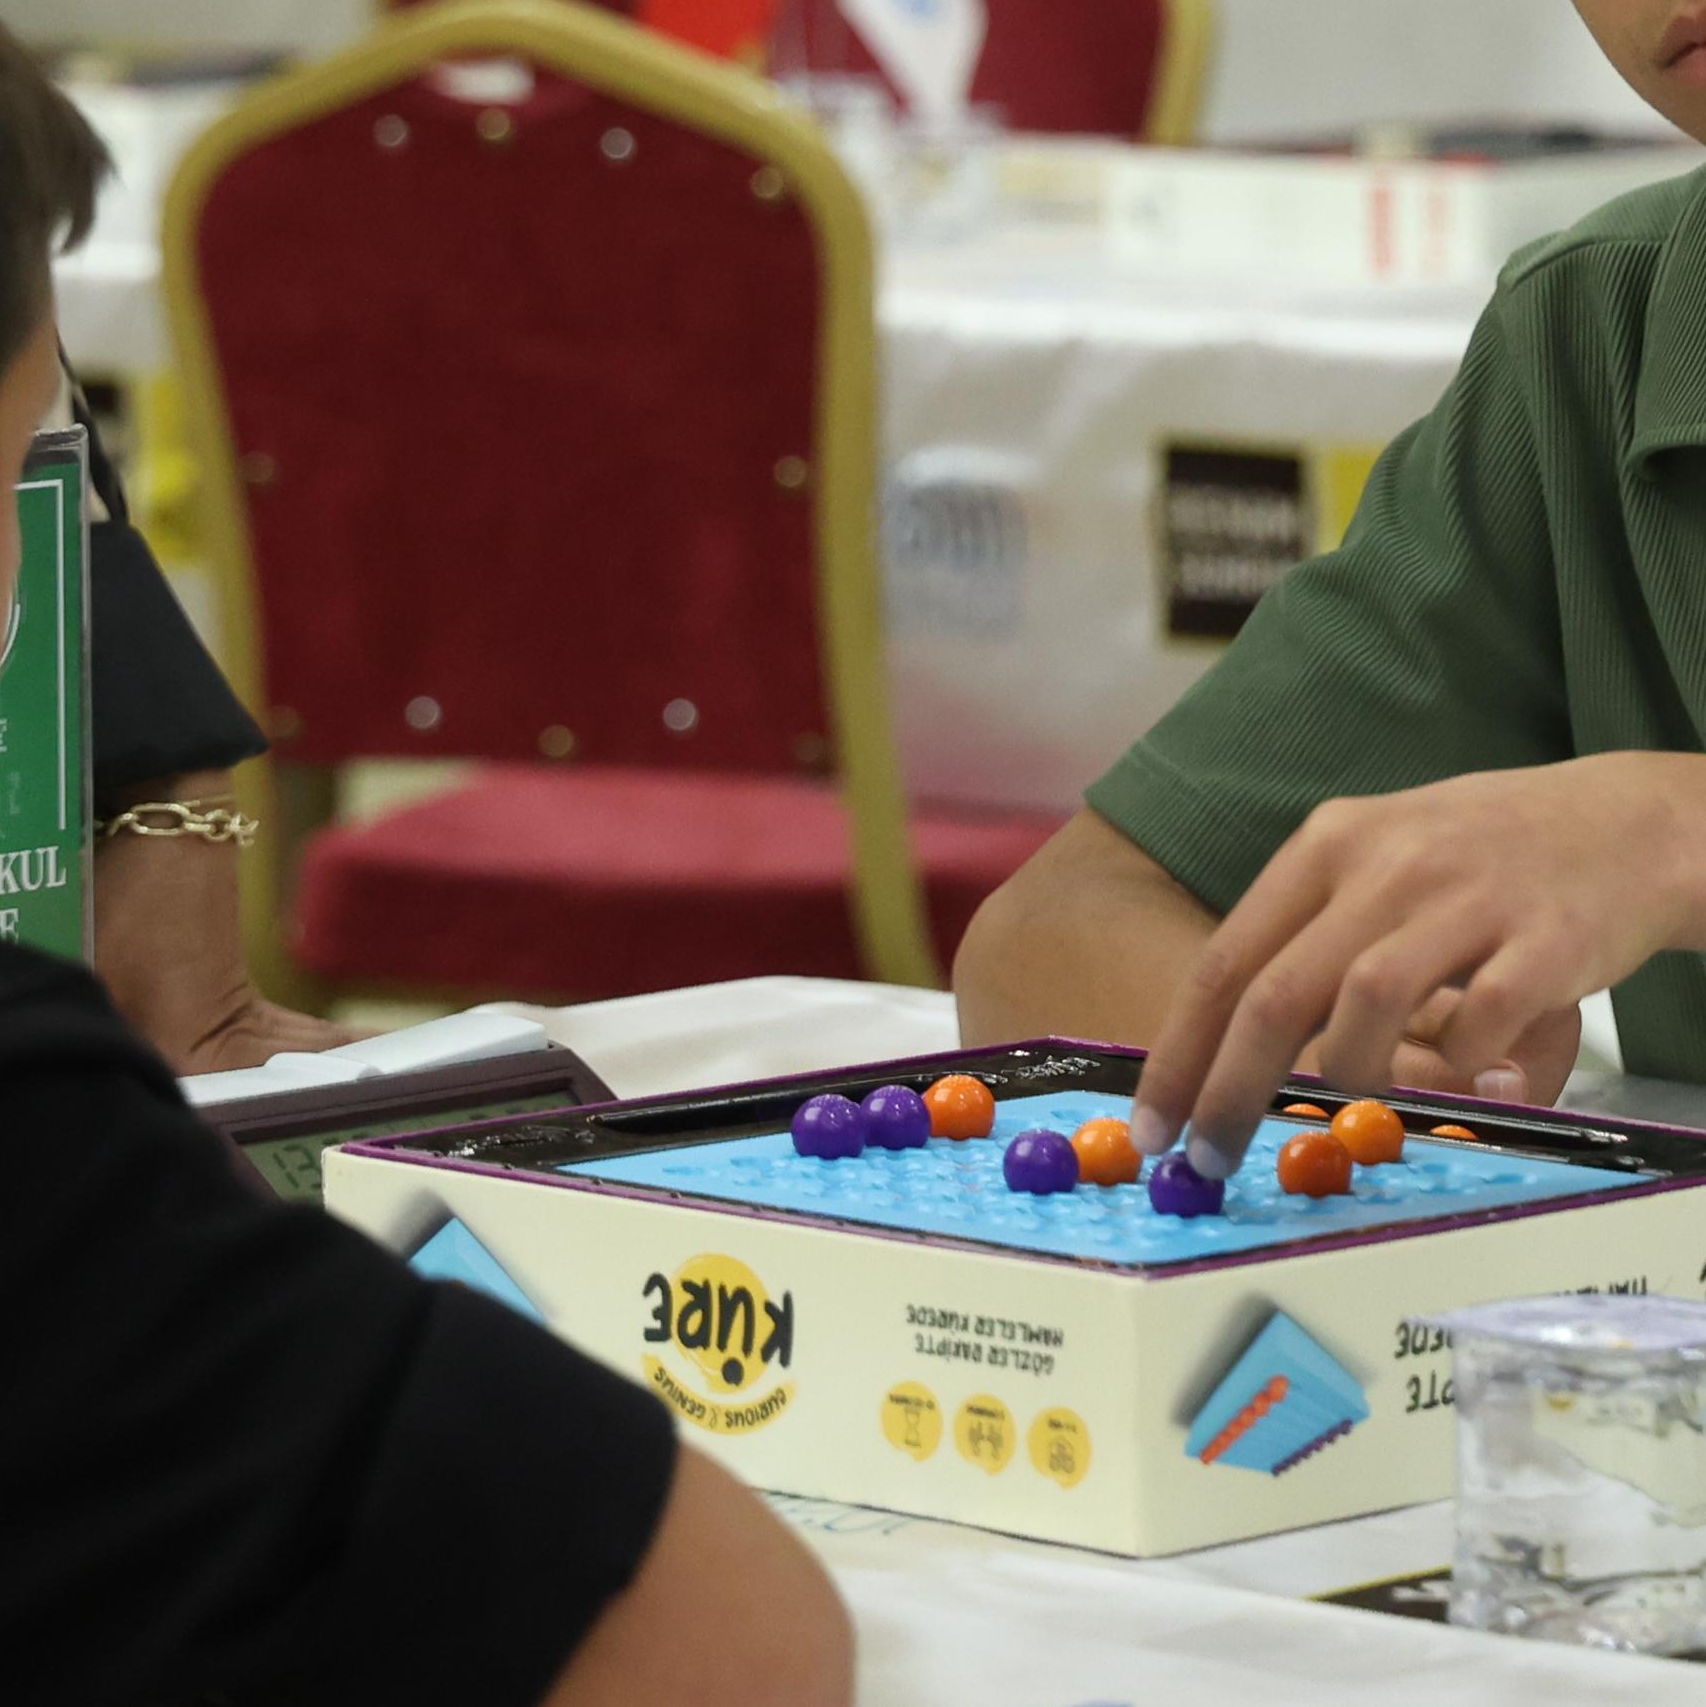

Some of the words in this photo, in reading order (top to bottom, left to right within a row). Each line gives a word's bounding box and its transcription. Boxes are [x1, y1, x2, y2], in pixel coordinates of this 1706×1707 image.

[642, 1273, 795, 1387] KÜRE
[905, 1303, 971, 1334] KÜREDE
[974, 1315, 1065, 1349] HAMLELER
[914, 1331, 984, 1365] RAKİPTE
[988, 1344, 1056, 1378] GÖZLER
[653, 1366, 707, 1419] GENIUS
[725, 1388, 787, 1429] CURIOUS
